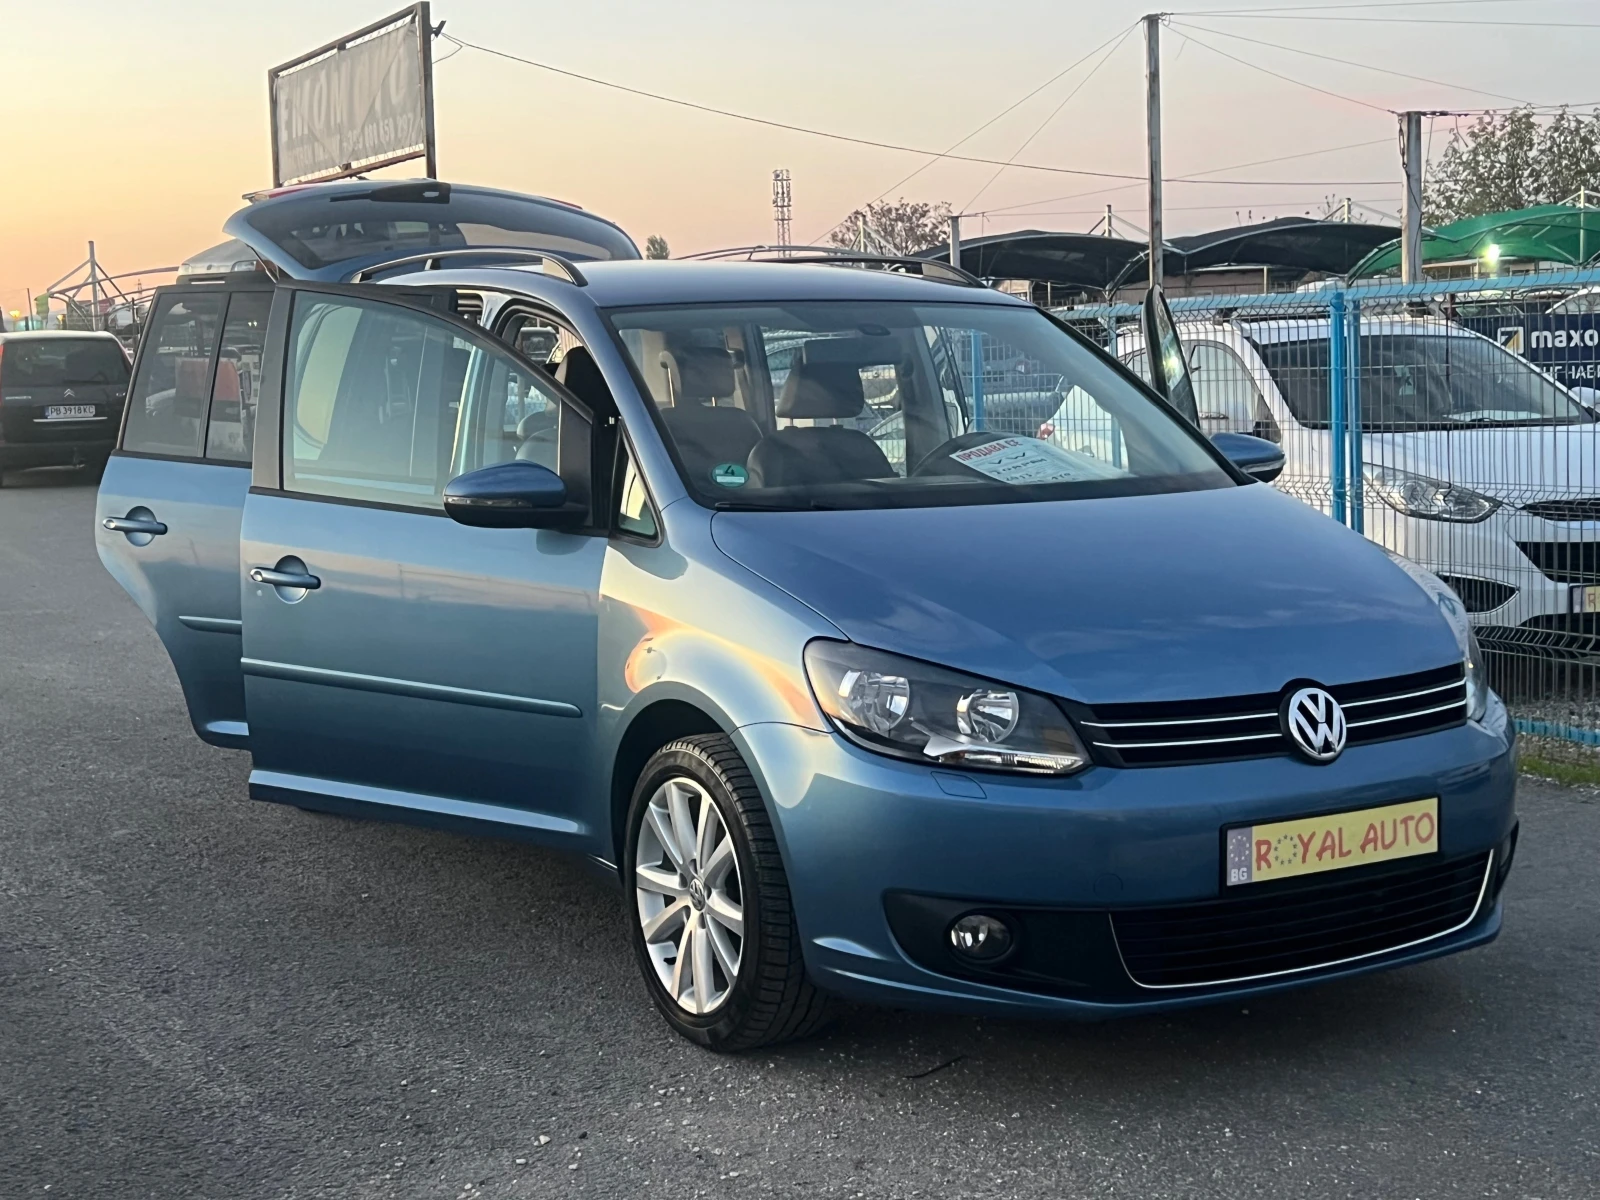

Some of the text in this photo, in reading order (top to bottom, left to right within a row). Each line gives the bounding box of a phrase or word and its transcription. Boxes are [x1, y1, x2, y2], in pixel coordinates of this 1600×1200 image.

[956, 445, 1006, 461] ПРОДАВА
[1255, 812, 1435, 871] ROYAL AUTO
[1230, 867, 1248, 882] BG
